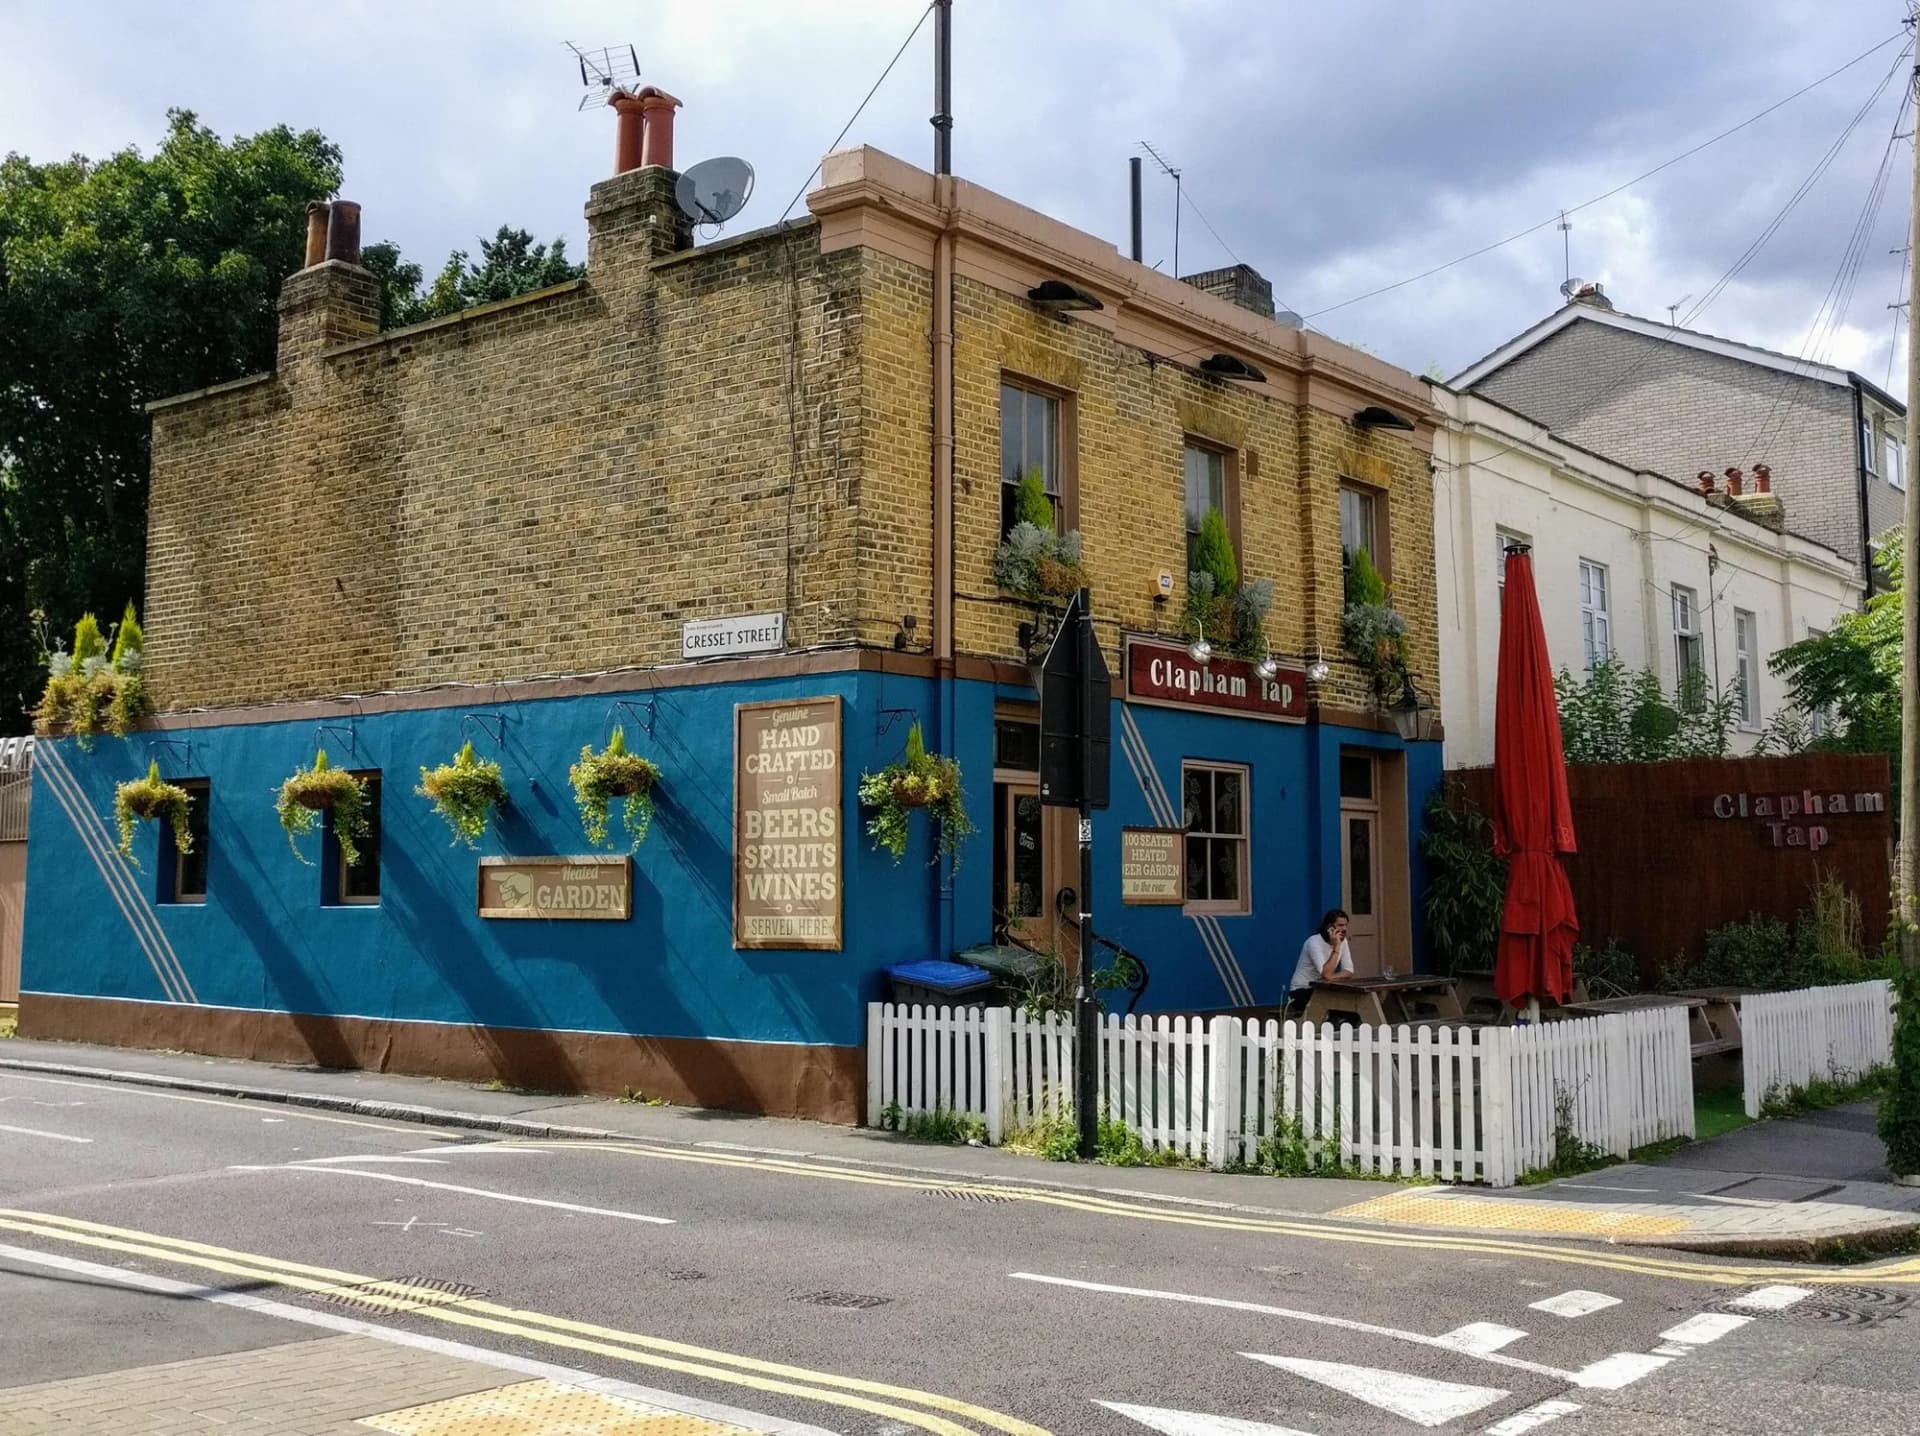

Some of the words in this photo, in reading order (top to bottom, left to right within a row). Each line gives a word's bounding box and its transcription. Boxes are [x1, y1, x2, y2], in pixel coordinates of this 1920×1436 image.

[686, 632, 733, 649] CRESSET
[737, 627, 779, 644] STREET
[1150, 658, 1247, 697] Clapham
[772, 707, 809, 727] Genuine
[761, 725, 820, 749] HAND
[745, 749, 836, 774] CRAFTED
[762, 788, 790, 805] Small
[791, 784, 817, 801] Batch
[1713, 789, 1885, 820] Clapham
[745, 807, 836, 839] BEERS
[1124, 833, 1139, 847] 100
[1140, 834, 1173, 848] SEATER
[1766, 821, 1830, 851] Tap
[744, 842, 836, 869] SPIRITS
[1132, 848, 1167, 862] HEATED
[1124, 863, 1142, 876] EER
[1143, 864, 1180, 877] GARDEN
[536, 884, 625, 909] GARDEN
[744, 872, 836, 901] WINES
[751, 918, 793, 936] SERVED
[799, 918, 828, 936] HERE
